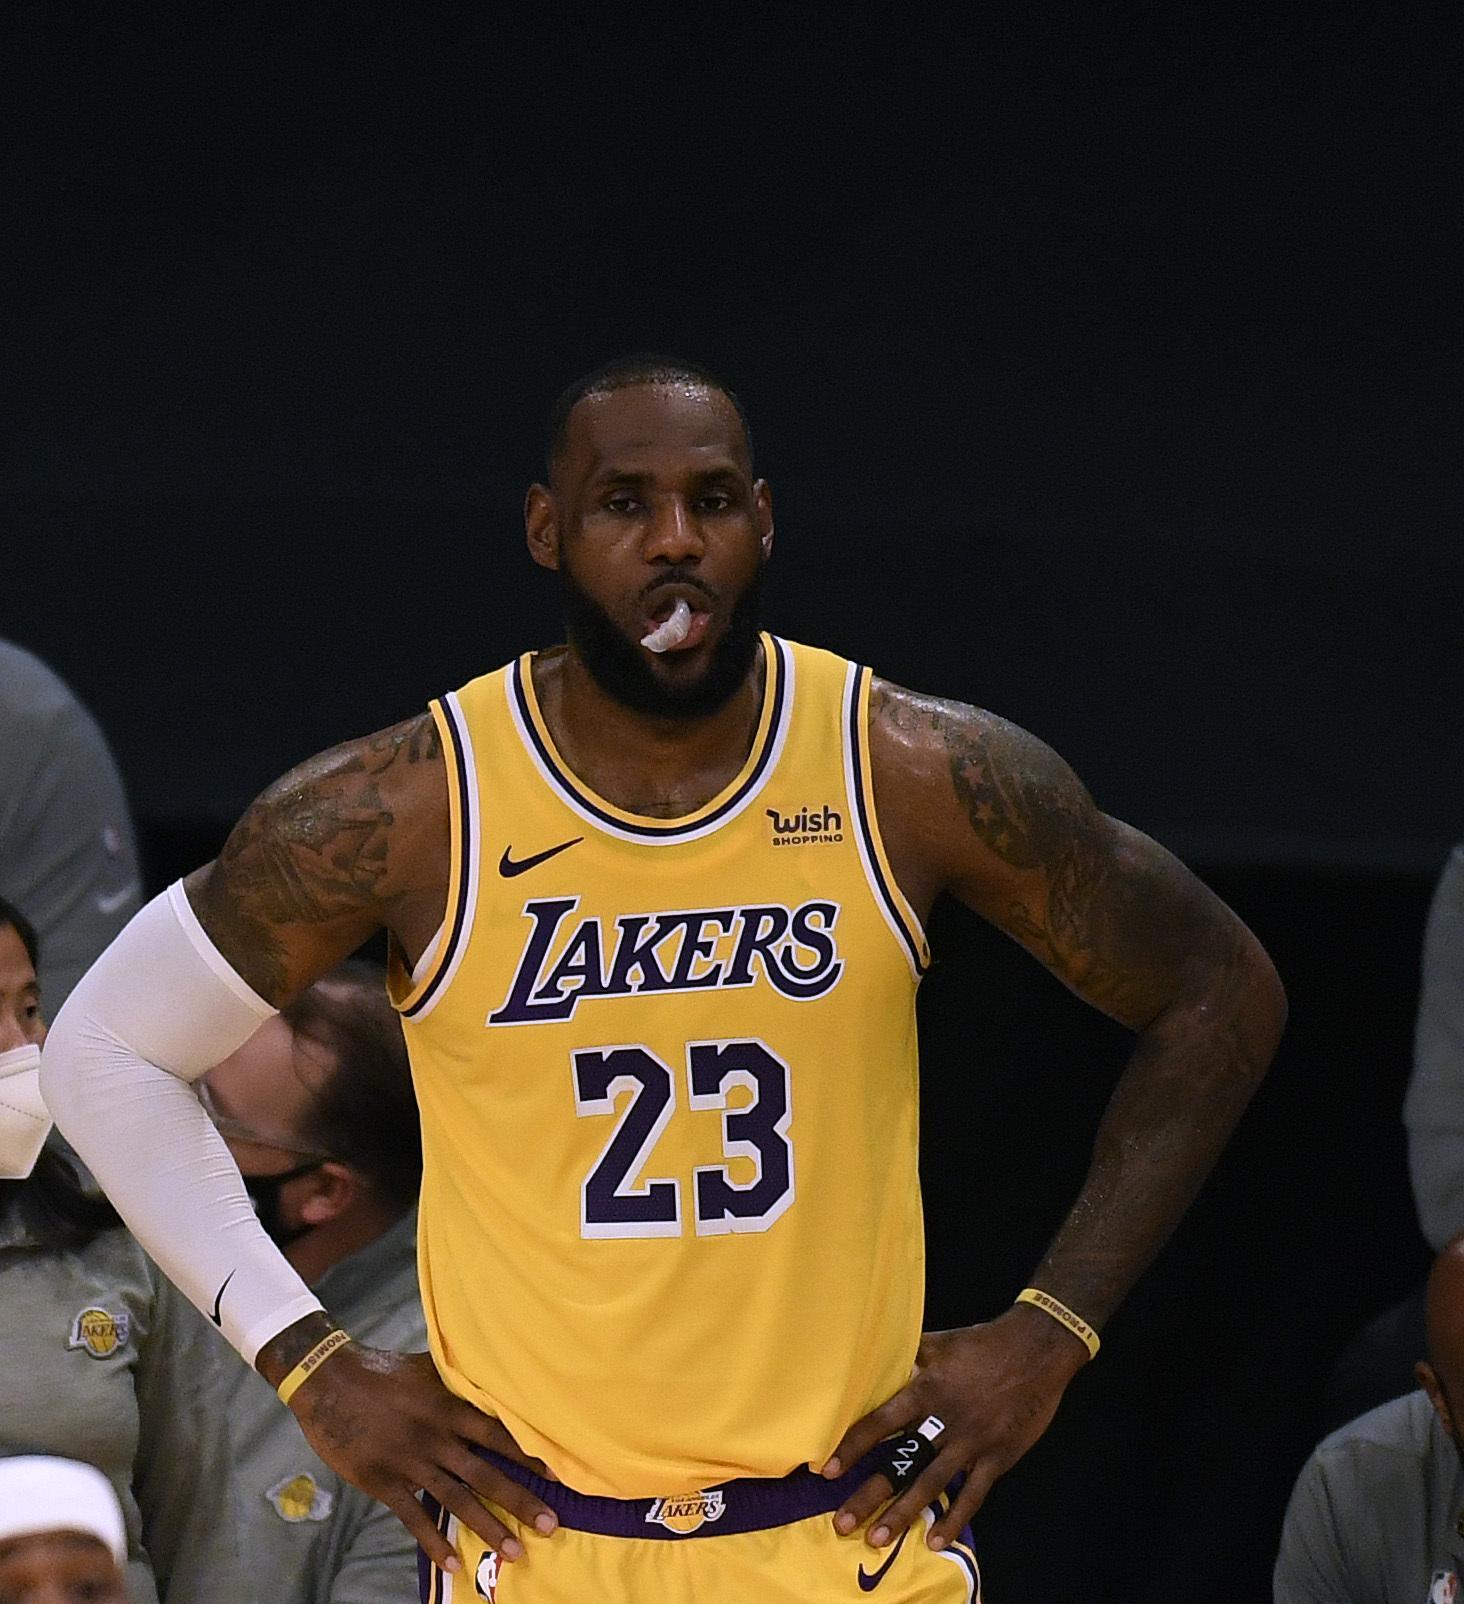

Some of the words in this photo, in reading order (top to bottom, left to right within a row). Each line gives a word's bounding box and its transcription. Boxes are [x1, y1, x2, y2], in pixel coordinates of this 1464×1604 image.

[765, 804, 842, 834] wish
[772, 834, 844, 847] SHOPPING
[487, 897, 843, 1025] LAKERS
[572, 1039, 793, 1237] 23
[649, 1497, 722, 1521] LAKERS
